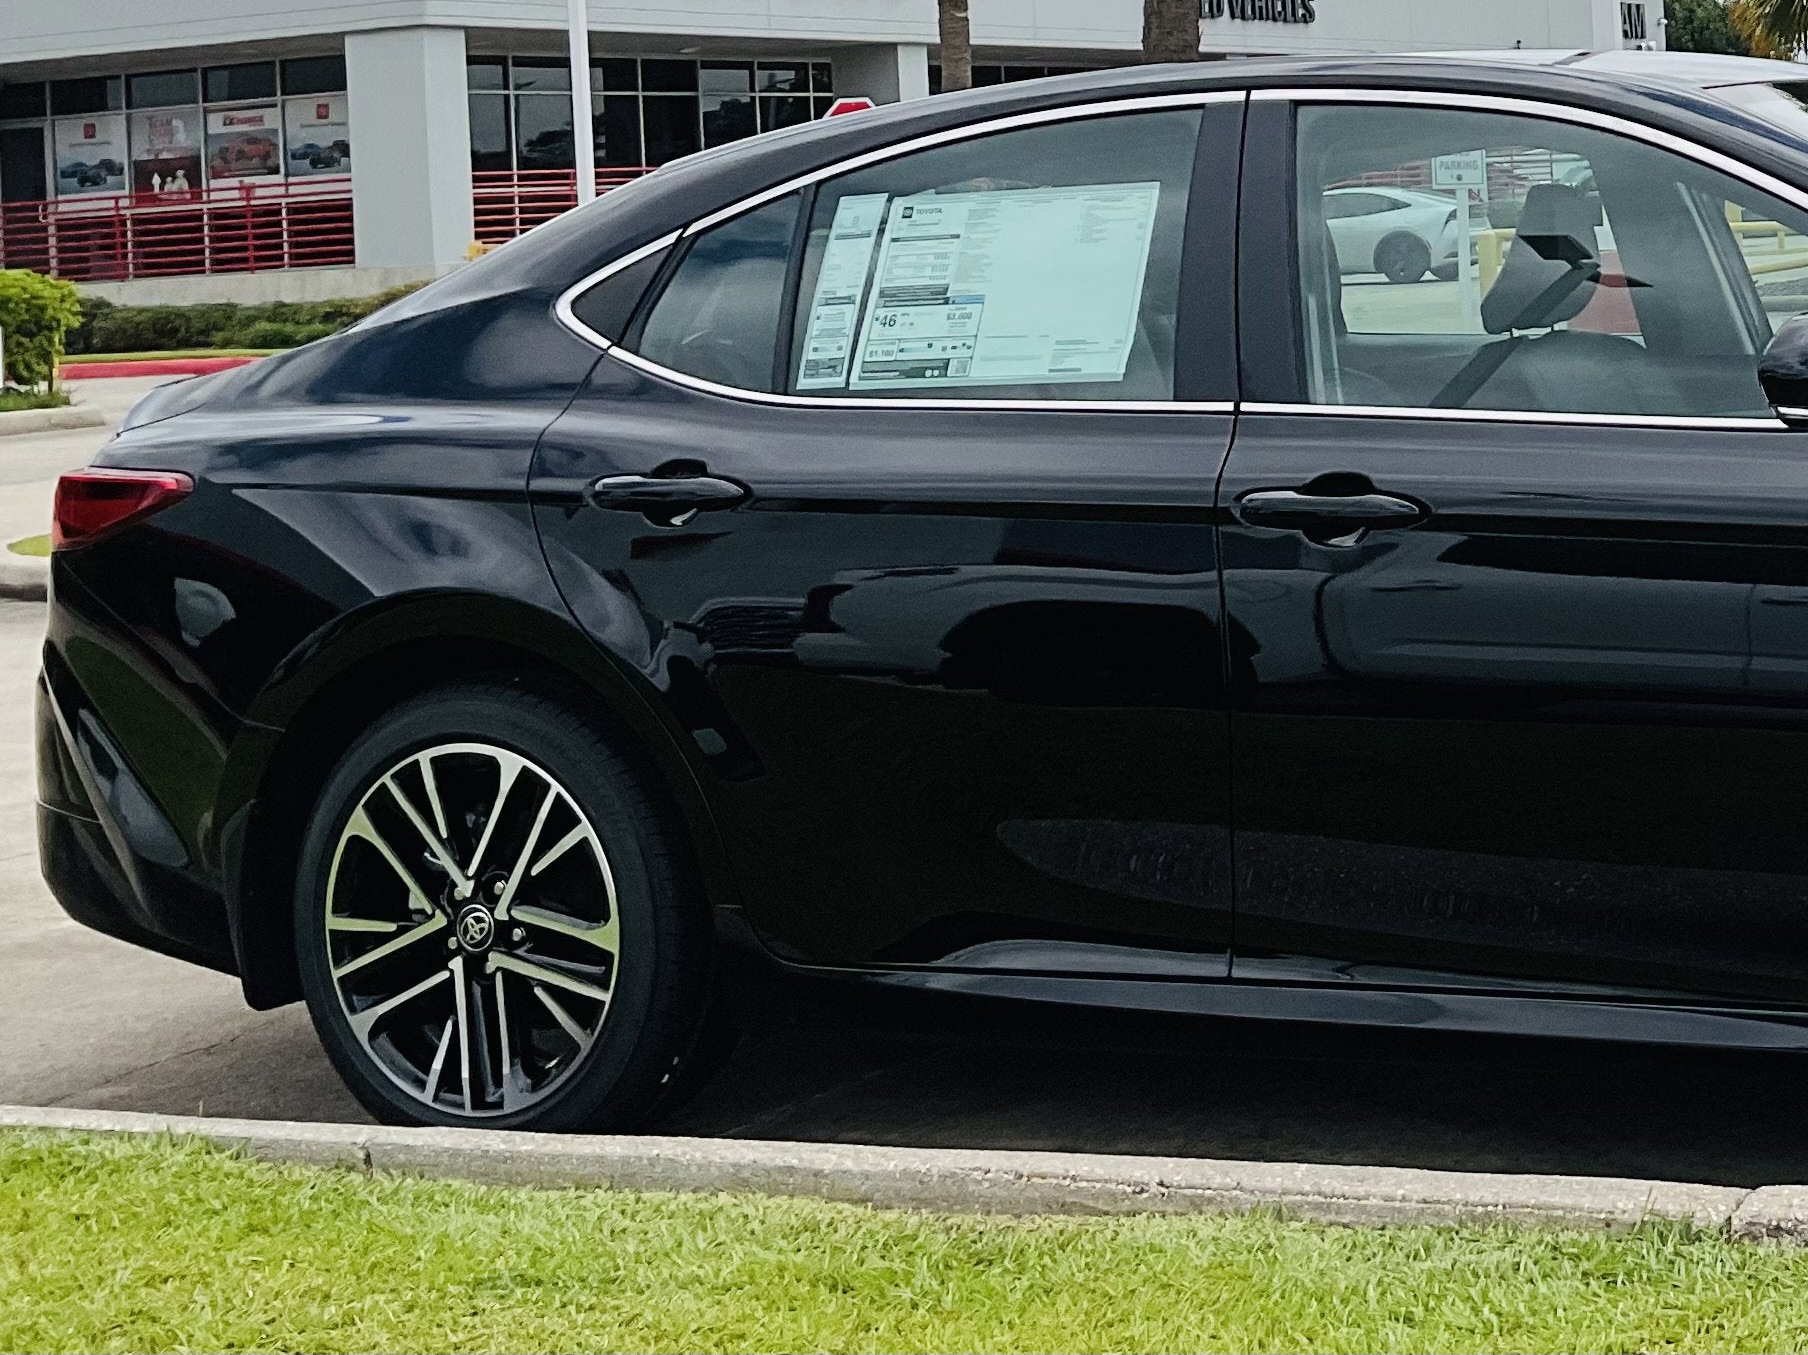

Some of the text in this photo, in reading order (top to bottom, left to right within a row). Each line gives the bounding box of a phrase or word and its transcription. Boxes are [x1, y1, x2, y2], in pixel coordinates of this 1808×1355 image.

[1620, 2, 1647, 40] AM
[1439, 160, 1479, 170] PARKING
[880, 314, 898, 328] 46
